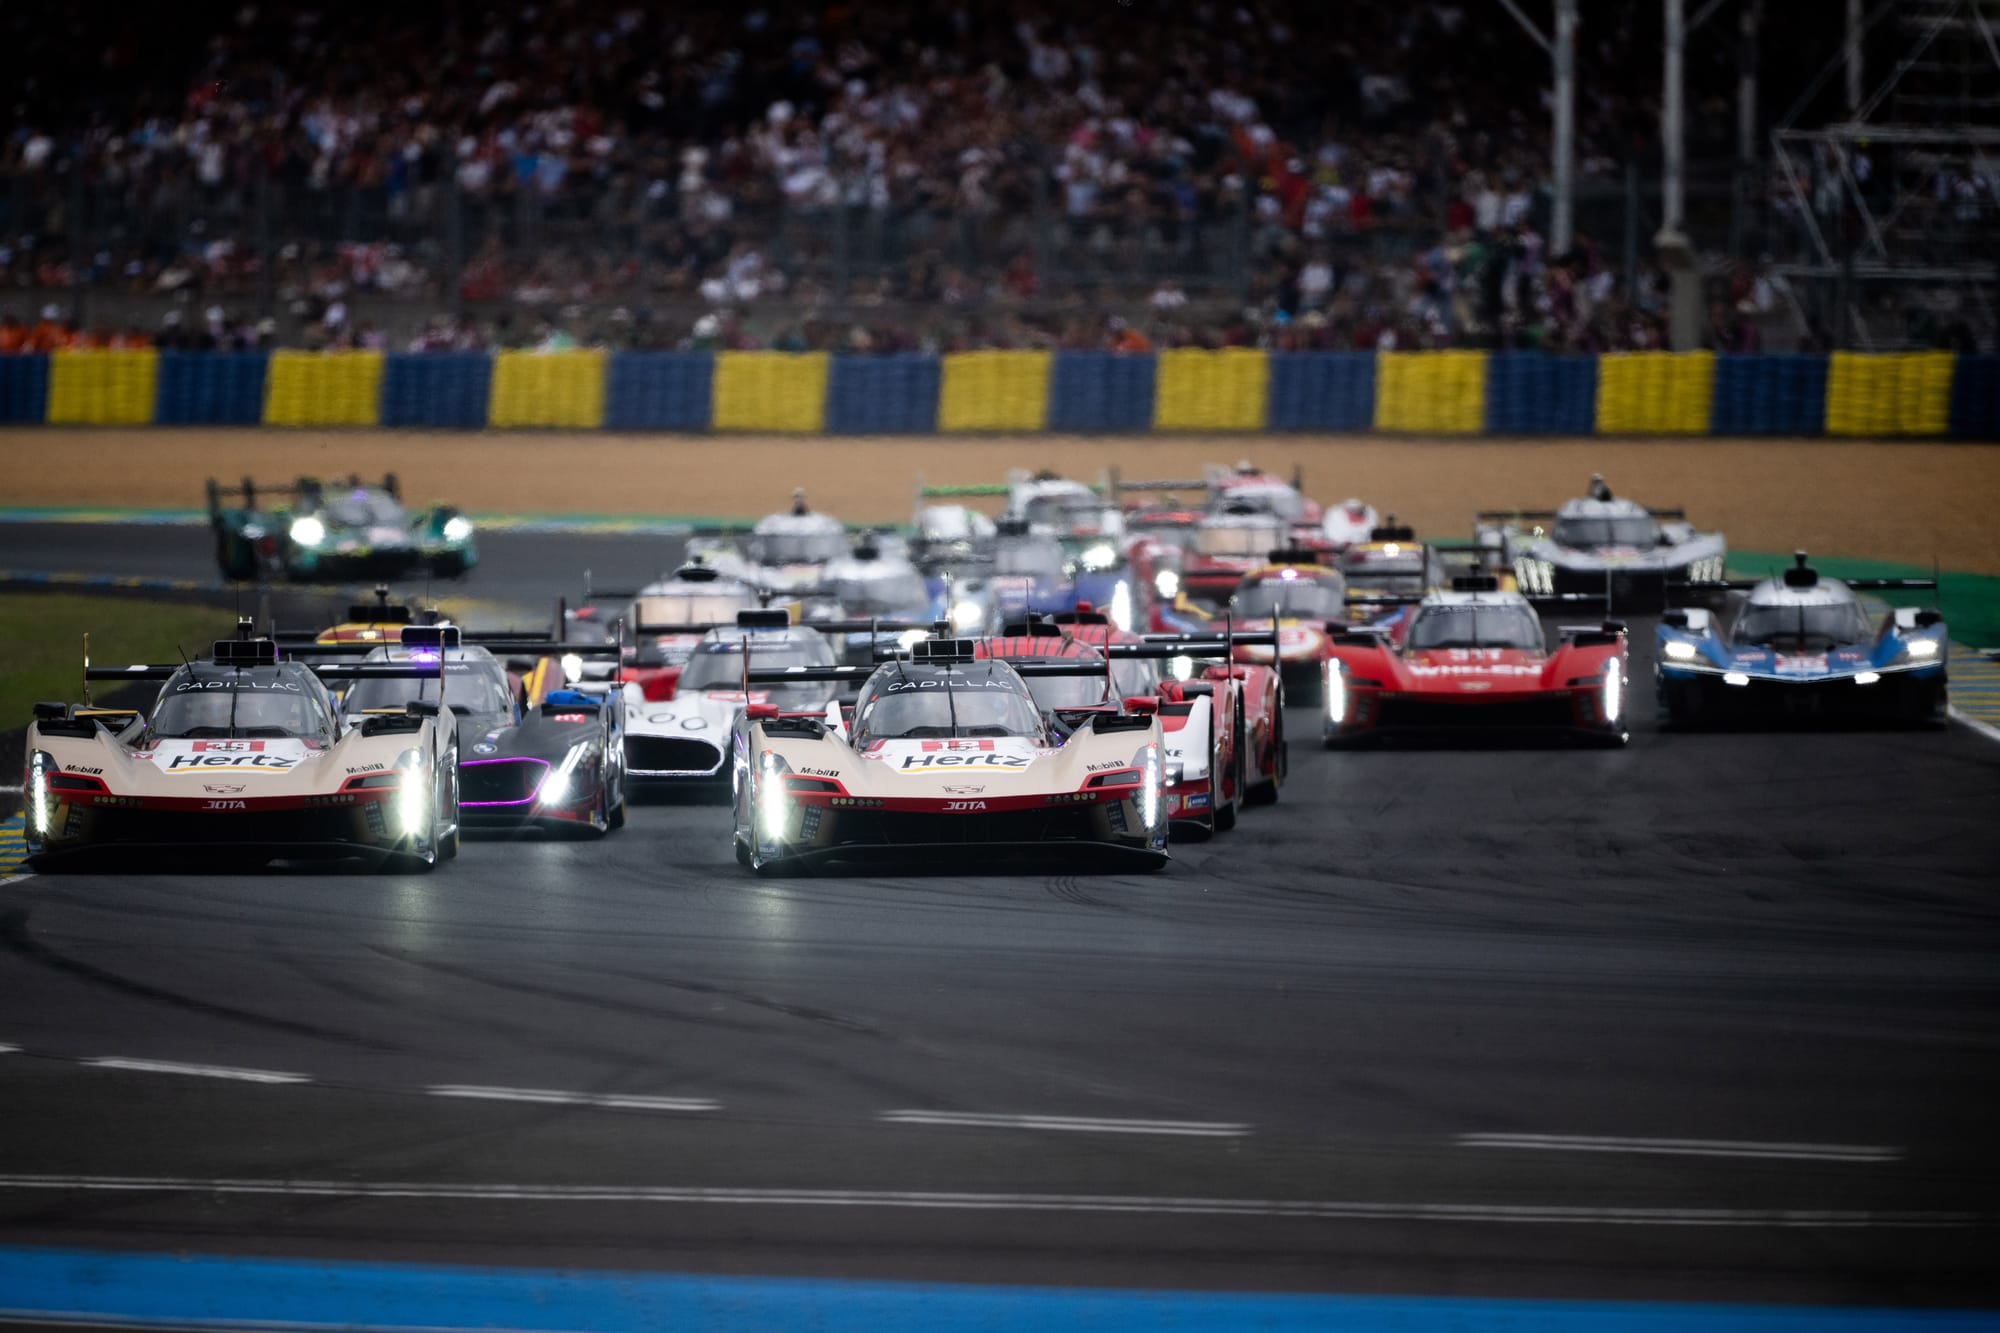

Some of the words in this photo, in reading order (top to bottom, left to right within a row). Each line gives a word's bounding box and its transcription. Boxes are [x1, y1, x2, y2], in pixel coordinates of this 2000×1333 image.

[1408, 665, 1542, 675] WHELEN
[176, 681, 300, 691] CADILLAC
[887, 680, 1013, 692] CADILLAC
[169, 754, 297, 769] Hertz
[901, 754, 1031, 769] Hertz
[202, 800, 246, 809] JOTA
[942, 801, 986, 810] JOTA
